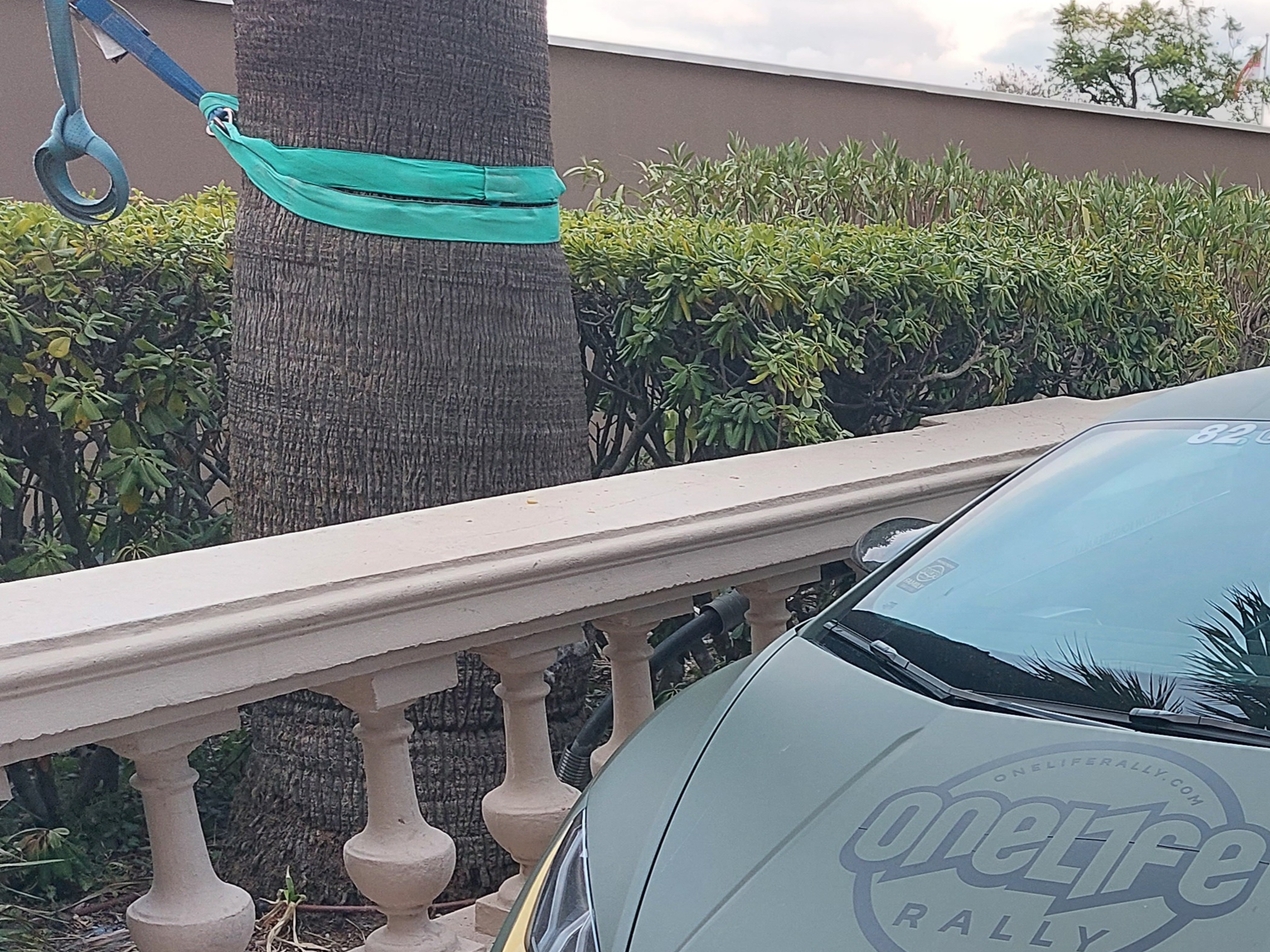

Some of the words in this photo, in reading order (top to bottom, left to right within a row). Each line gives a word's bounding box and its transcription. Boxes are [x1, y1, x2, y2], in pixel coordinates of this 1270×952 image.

[1187, 424, 1257, 445] 82
[994, 757, 1204, 807] ONELIFERALLY.COM
[892, 902, 1111, 952] RALLY
